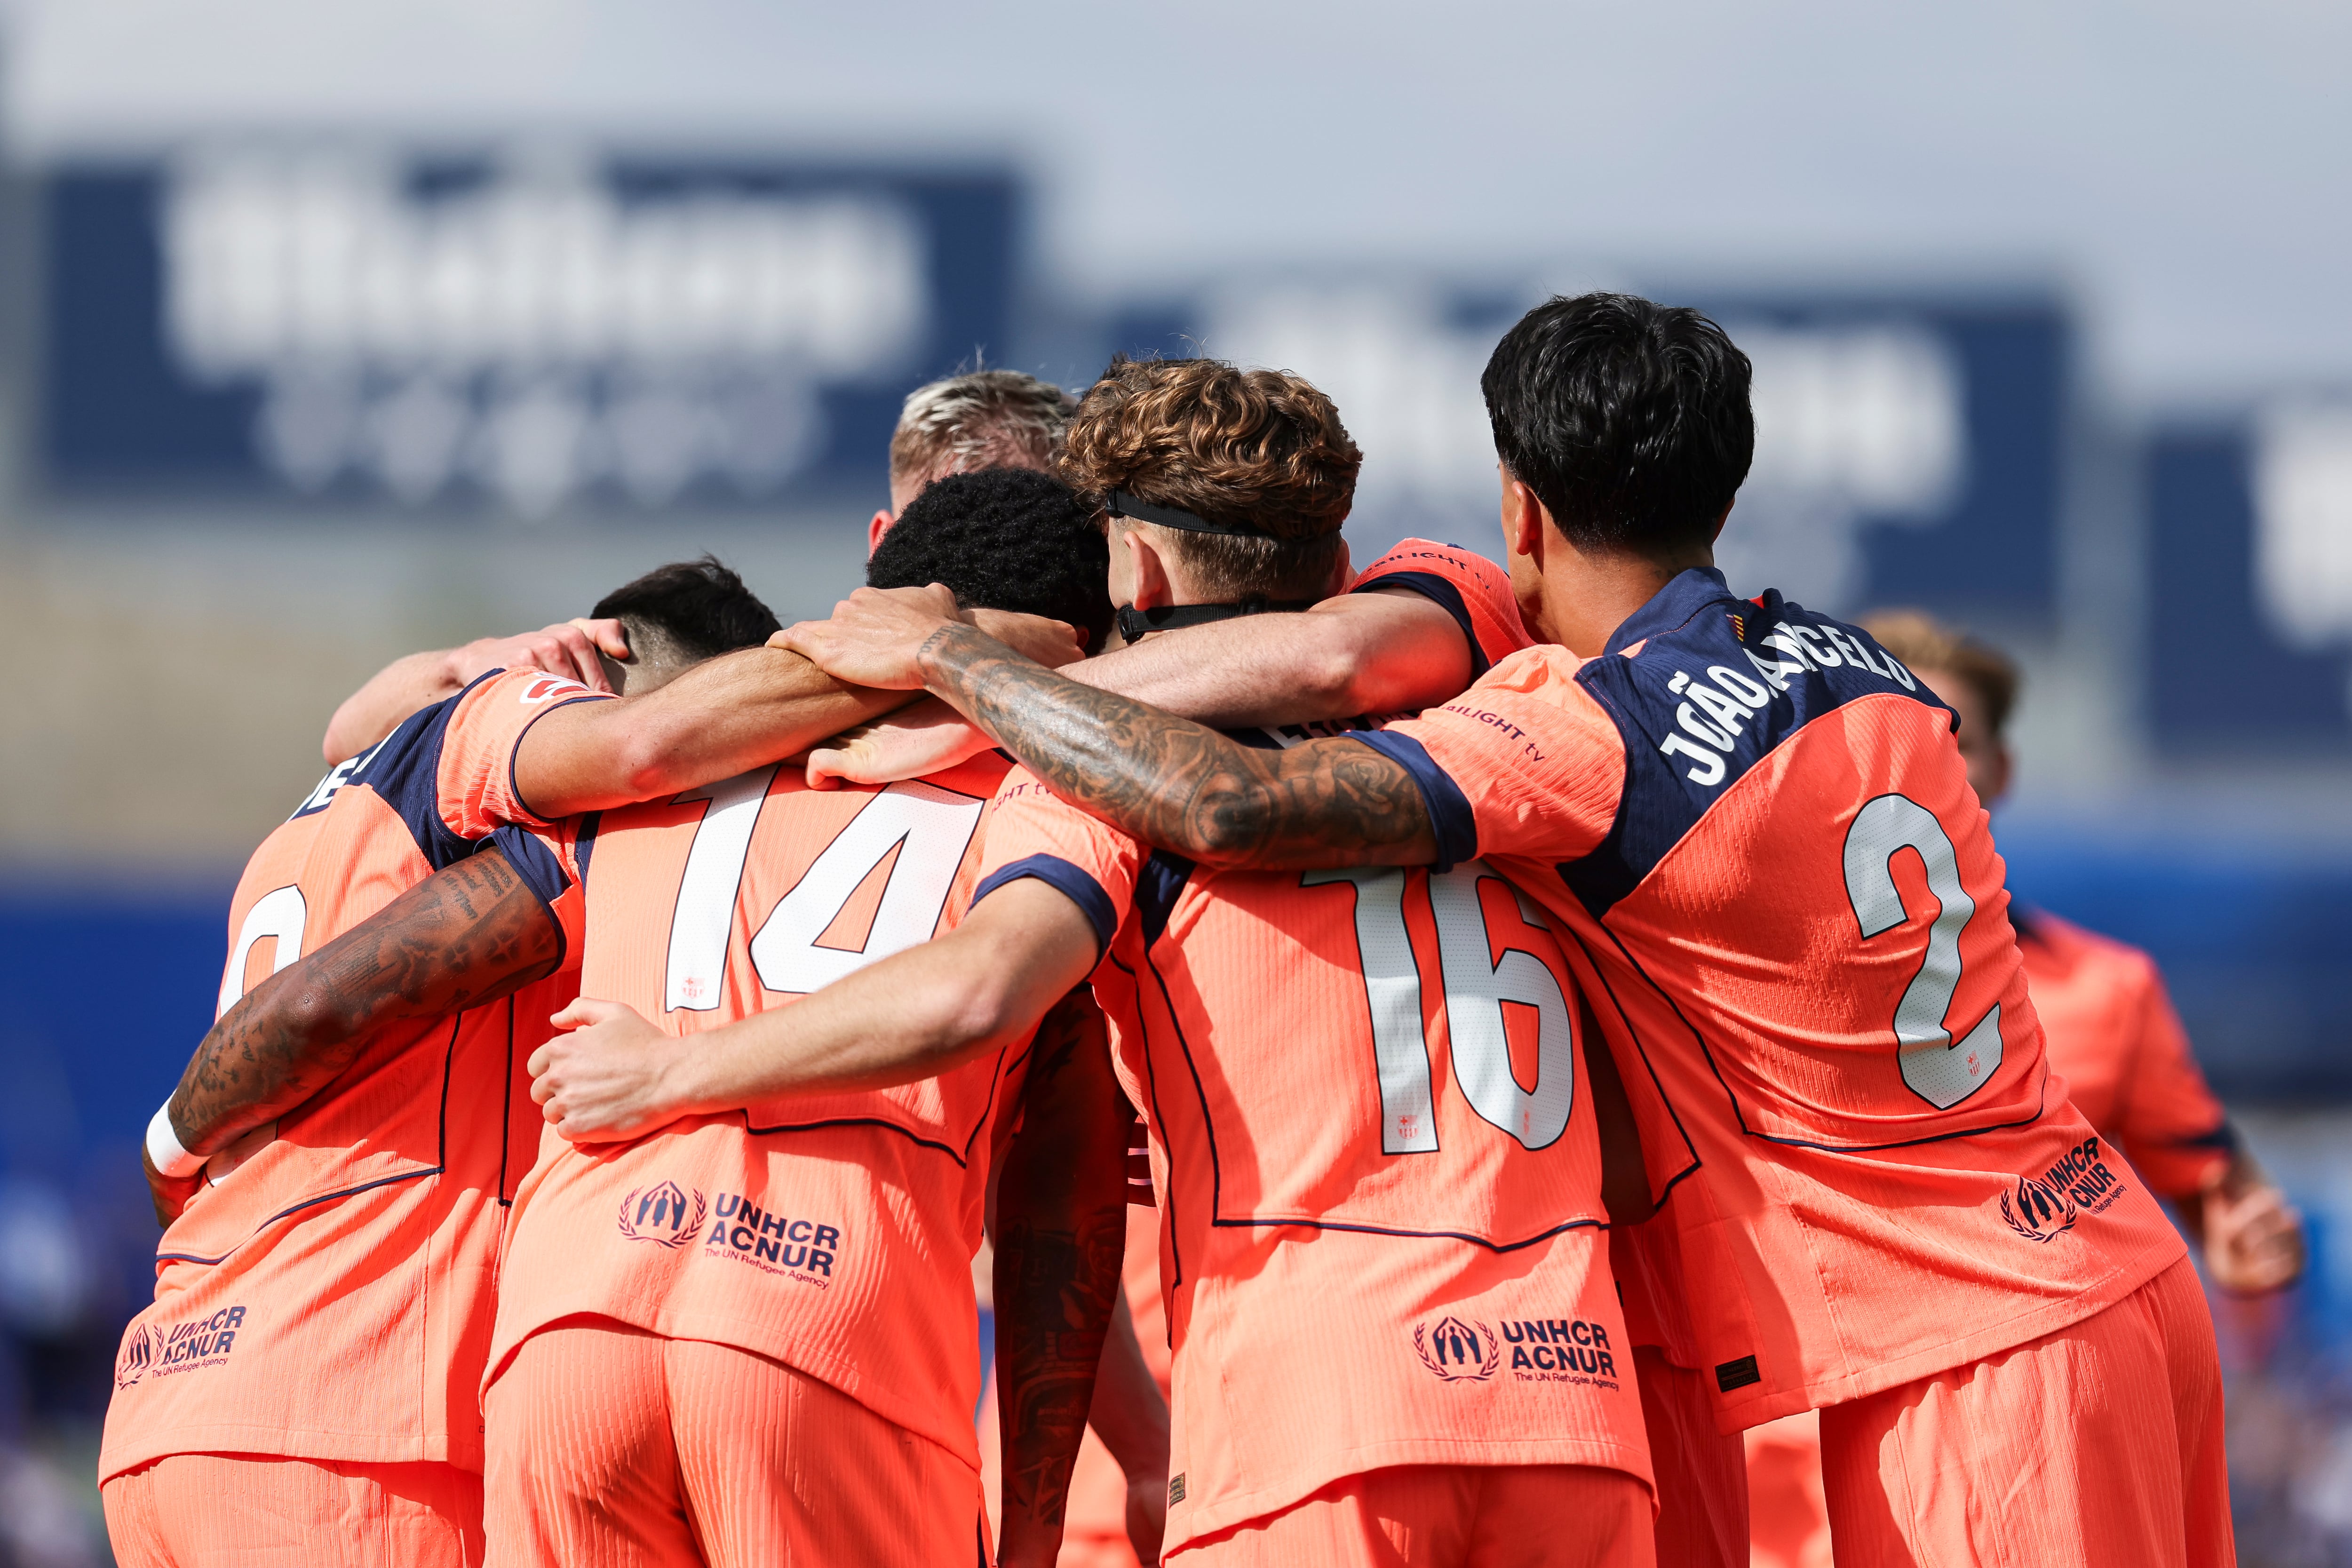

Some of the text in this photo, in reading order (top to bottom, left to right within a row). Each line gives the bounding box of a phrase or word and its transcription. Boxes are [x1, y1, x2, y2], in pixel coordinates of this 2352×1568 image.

[1659, 670, 1770, 786] JOÃO
[1526, 742, 1545, 762] tv
[666, 765, 987, 1013] 14
[1842, 792, 2003, 1111] 2
[1299, 859, 1574, 1155] 16
[2069, 1162, 2117, 1208] CNUR
[2095, 1197, 2114, 1213] Refugee
[2109, 1183, 2127, 1200] Agency
[715, 1193, 840, 1250] UNHCR
[707, 1220, 834, 1277] ACNUR
[705, 1248, 829, 1290] The UN Refugee Agency
[167, 1306, 246, 1344] UNHCR
[1500, 1320, 1611, 1350] UNHCR
[152, 1357, 228, 1378] The UN Refugee Agency
[161, 1331, 236, 1365] ACNUR
[1511, 1345, 1617, 1378] ACNUR
[1514, 1372, 1620, 1392] The UN Refugee Agency
